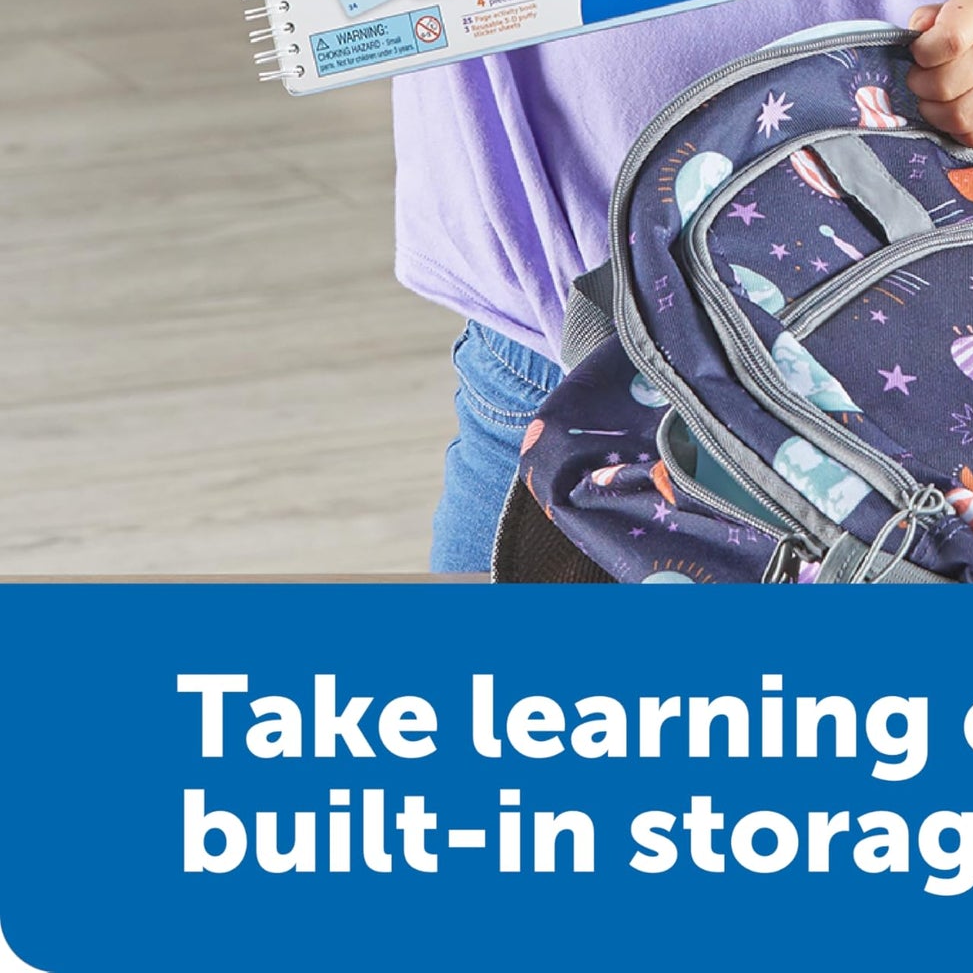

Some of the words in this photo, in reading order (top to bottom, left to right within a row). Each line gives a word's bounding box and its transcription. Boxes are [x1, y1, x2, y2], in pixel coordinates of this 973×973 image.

[336, 23, 389, 45] WARNING:
[318, 46, 351, 62] CHOKING
[352, 40, 380, 53] HAZARD
[385, 36, 401, 46] Small
[355, 52, 376, 63] children
